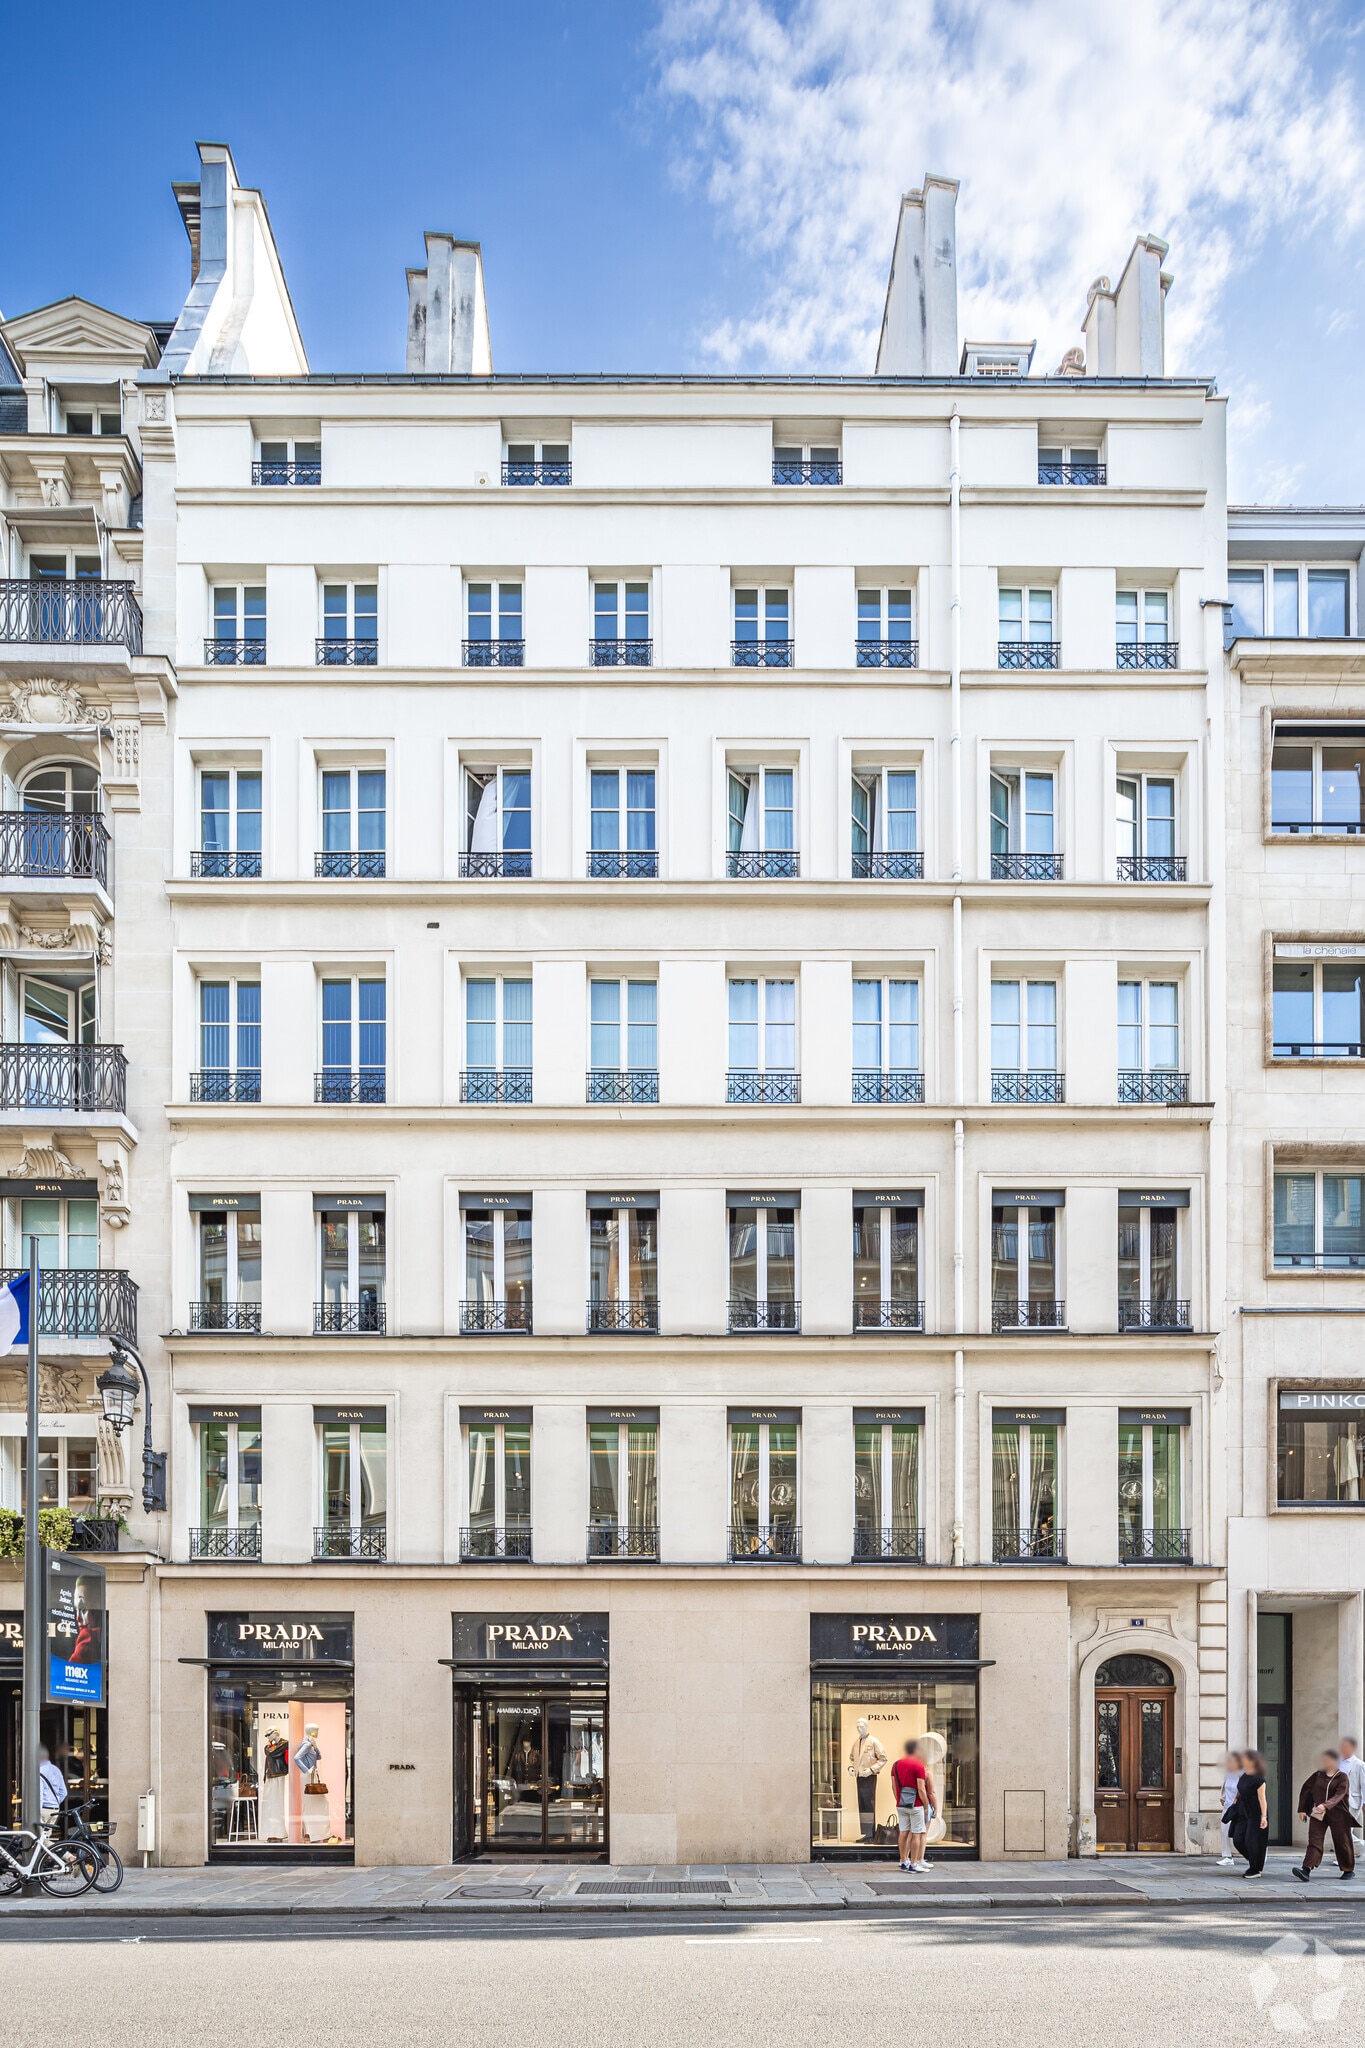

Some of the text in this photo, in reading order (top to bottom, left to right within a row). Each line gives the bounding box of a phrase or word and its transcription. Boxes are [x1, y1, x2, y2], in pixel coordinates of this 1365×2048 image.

[238, 1624, 324, 1640] PRADA
[487, 1625, 574, 1641] PRADA
[852, 1625, 937, 1642] PRADA
[263, 1641, 300, 1649] MILANO
[512, 1642, 549, 1650] MILANO
[876, 1642, 913, 1650] MILANO
[65, 1665, 88, 1679] max
